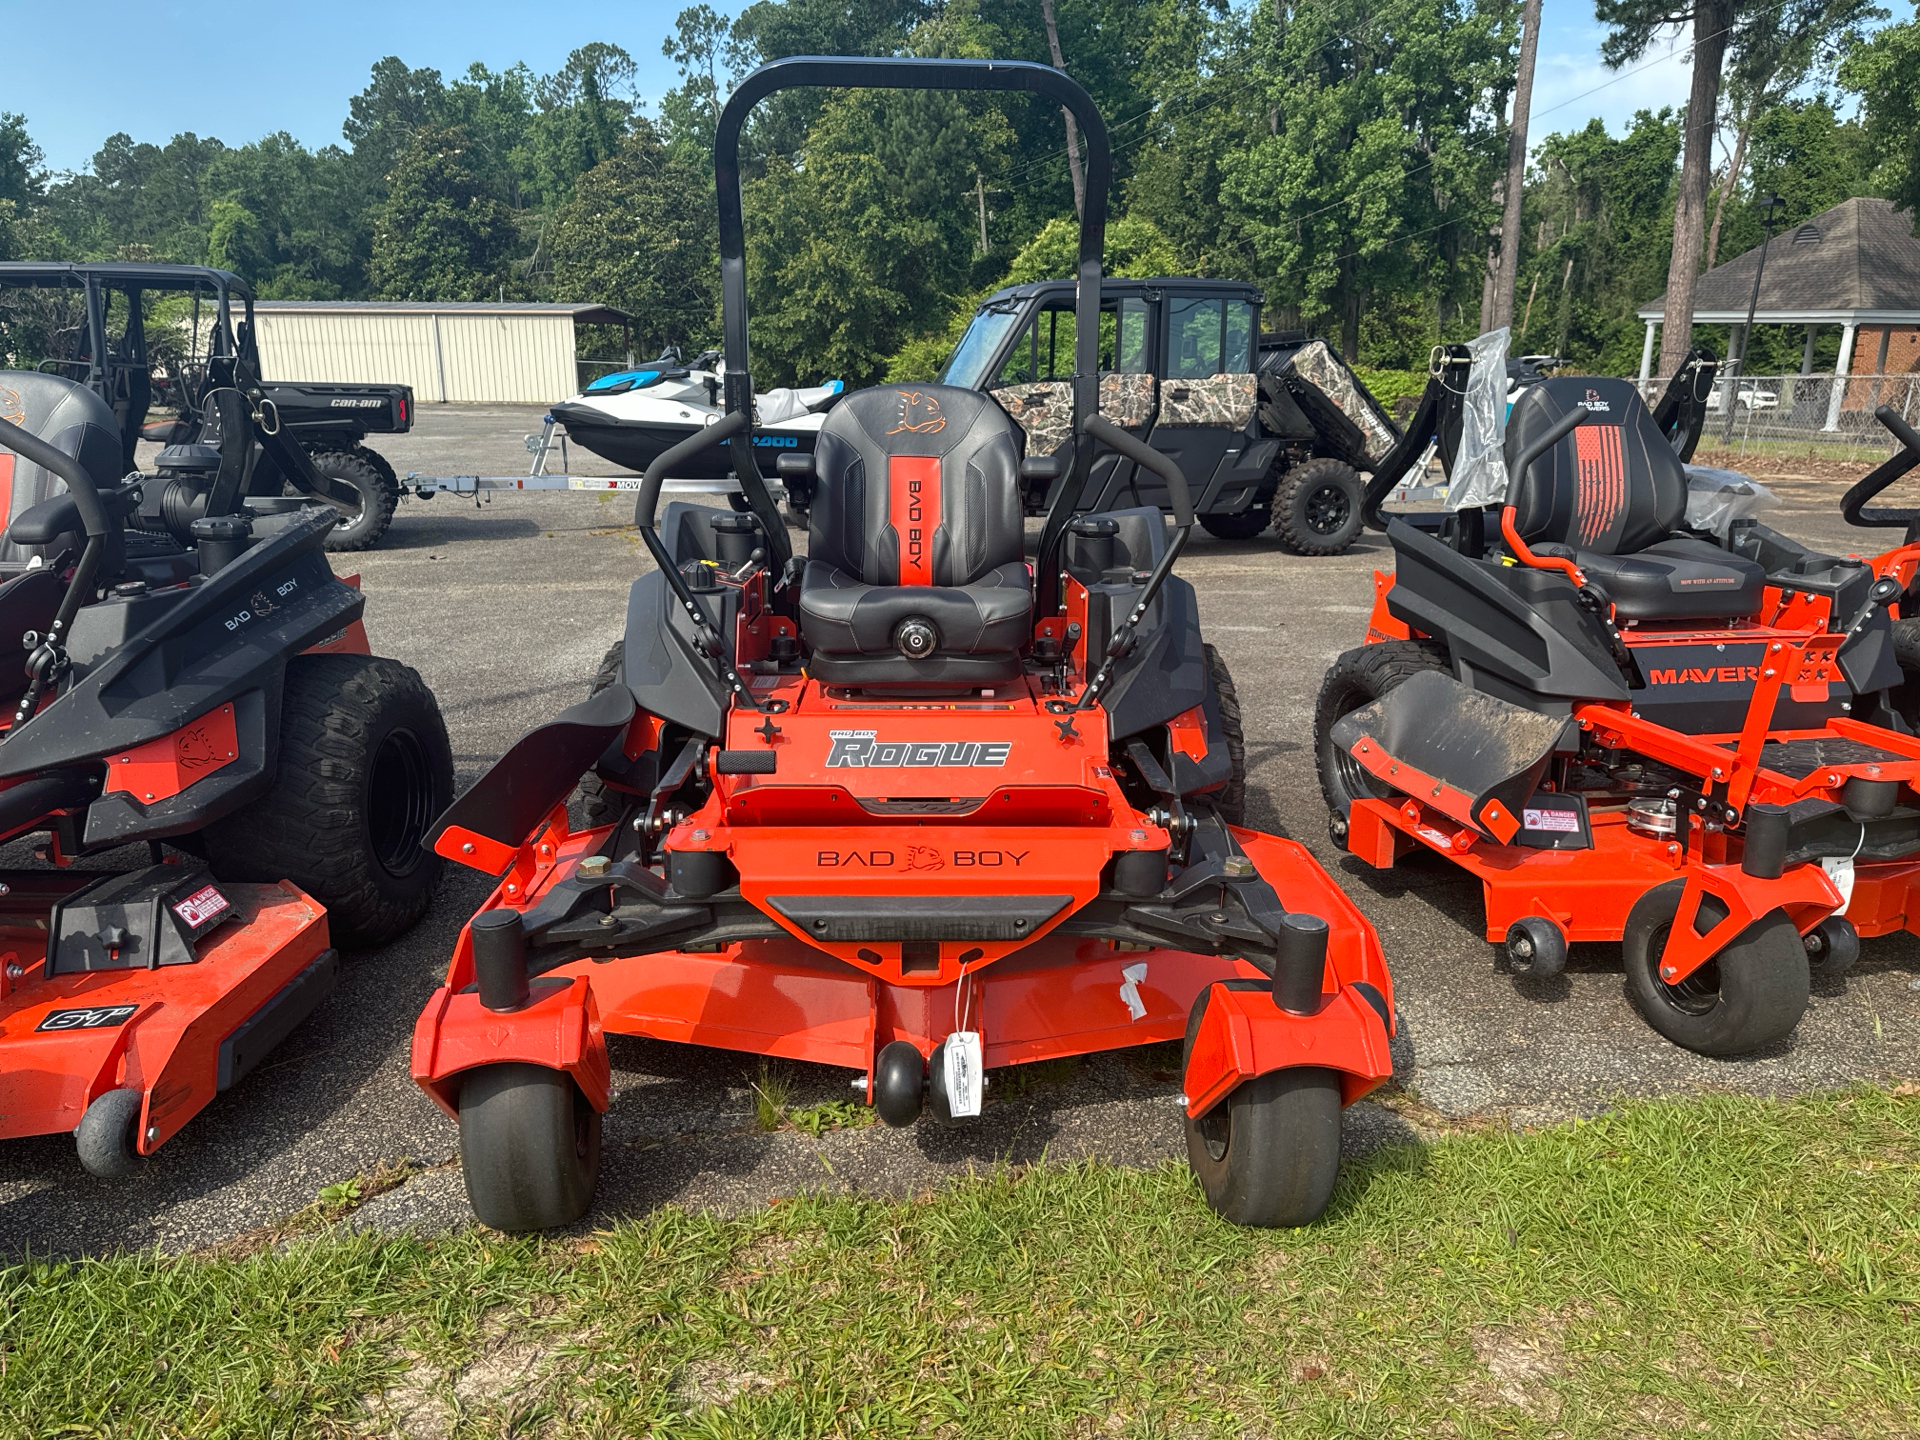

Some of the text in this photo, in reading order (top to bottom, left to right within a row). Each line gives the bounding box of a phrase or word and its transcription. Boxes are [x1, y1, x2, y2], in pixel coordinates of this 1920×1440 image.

[330, 399, 382, 408] can-am
[908, 480, 922, 570] BAD BOY
[224, 577, 299, 631] BAD BOY
[825, 736, 1013, 768] ROGUE
[817, 851, 1031, 867] BAD BOY
